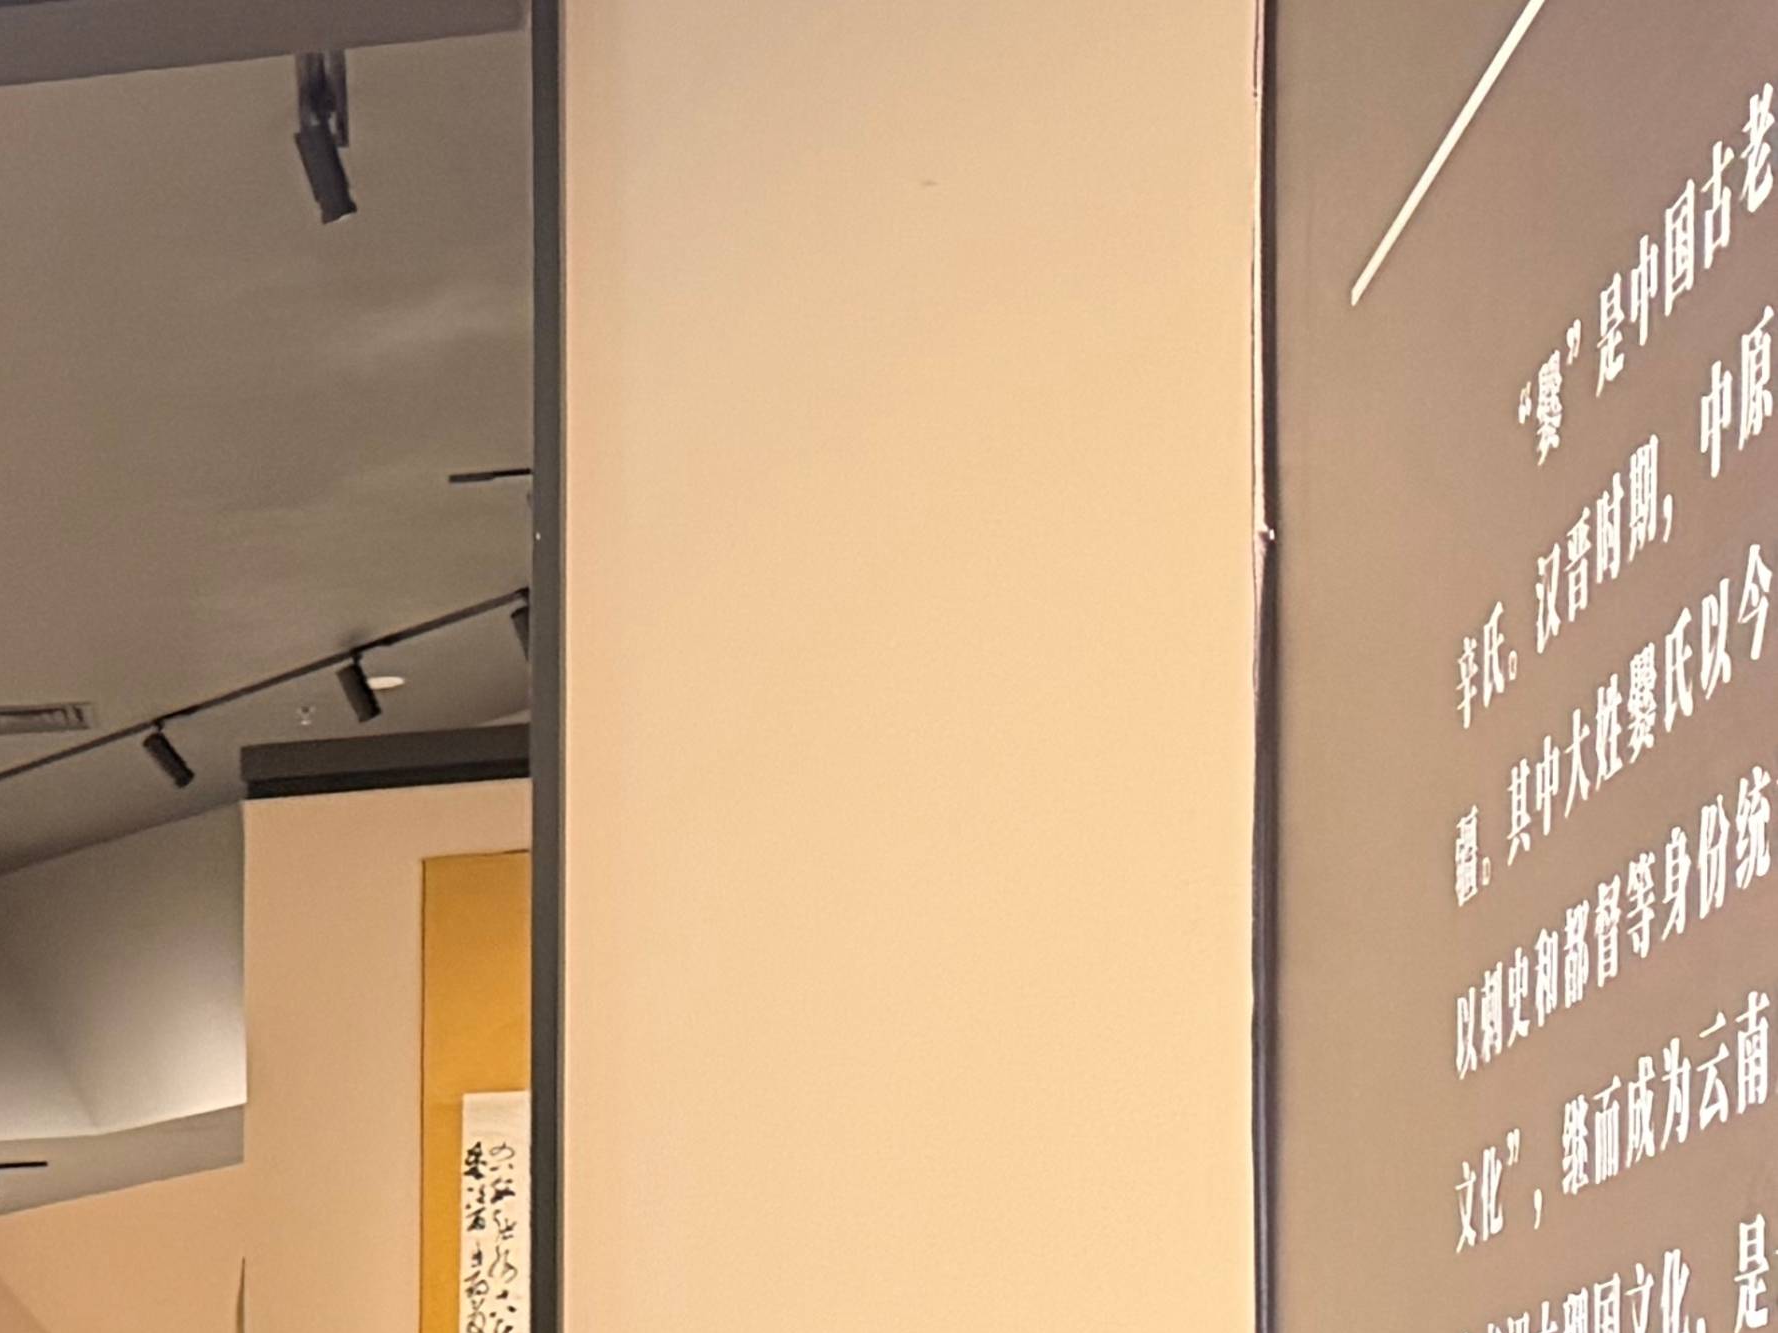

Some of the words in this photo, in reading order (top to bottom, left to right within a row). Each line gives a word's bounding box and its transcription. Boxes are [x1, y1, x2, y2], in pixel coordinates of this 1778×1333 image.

[1455, 766, 1778, 1081] 以刺史和都督等身份统
[1455, 990, 1778, 1254] 文化”,继而成为云南
